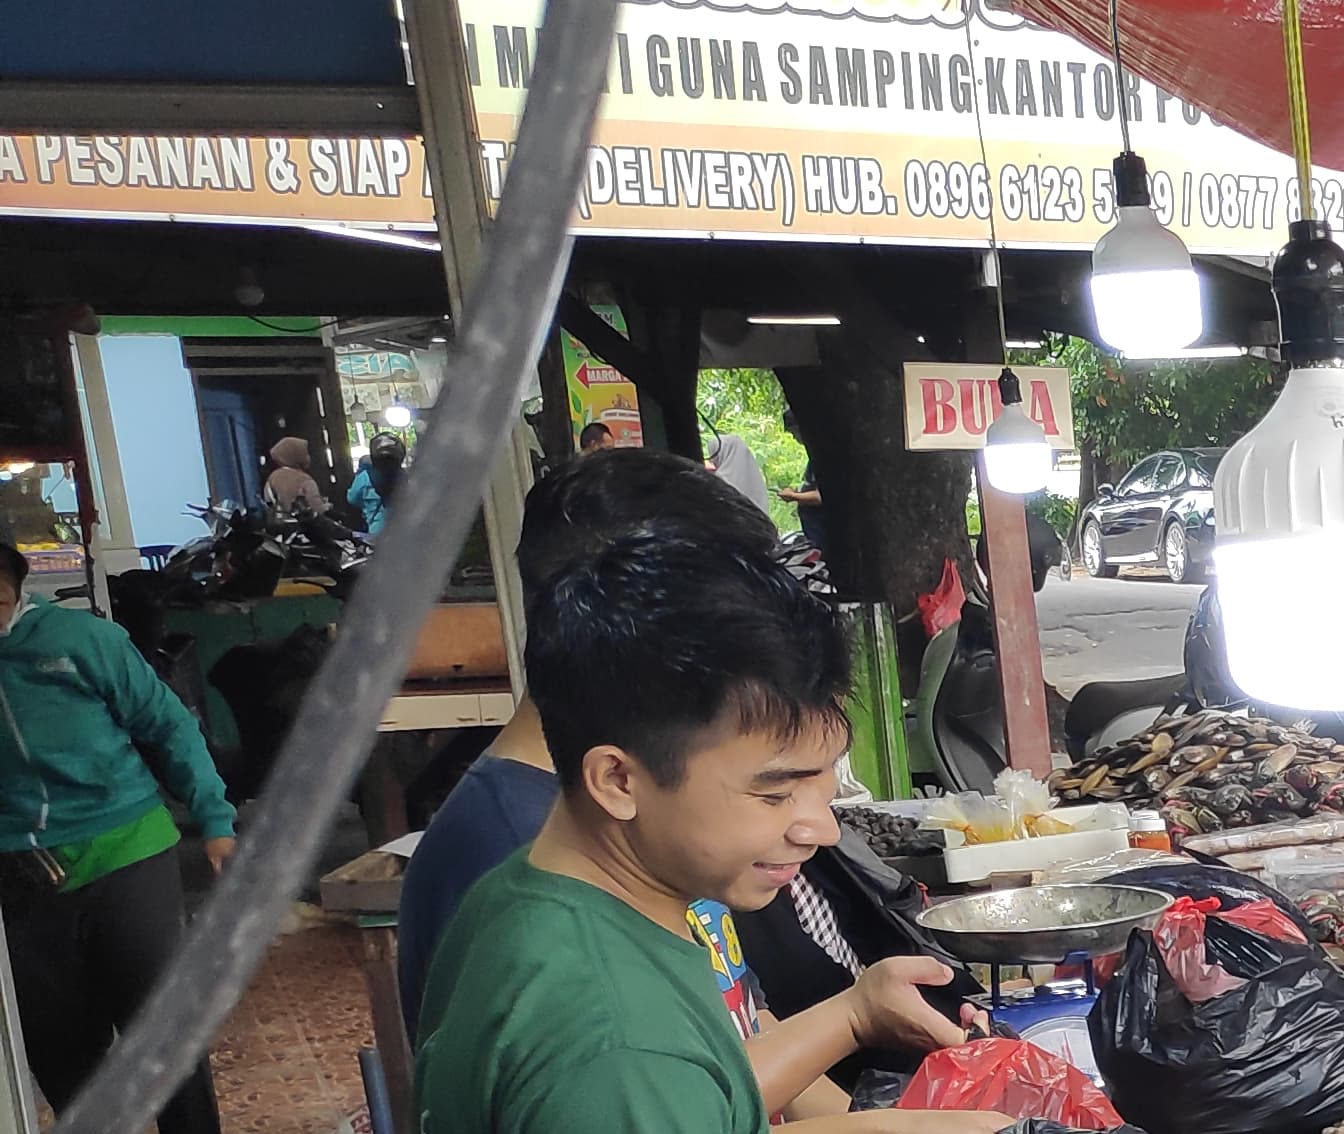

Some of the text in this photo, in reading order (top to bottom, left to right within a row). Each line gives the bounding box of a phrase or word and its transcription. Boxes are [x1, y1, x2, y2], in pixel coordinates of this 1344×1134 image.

[646, 33, 768, 102] GUNA
[778, 42, 973, 114] SAMPING
[984, 56, 1142, 122] KANTOR
[35, 136, 255, 193] PESANAN
[264, 136, 300, 194] &
[308, 138, 410, 197] SIAP
[577, 146, 795, 226] (DELIVERY)
[802, 156, 898, 215] HUB.
[904, 159, 992, 219] 0896
[1000, 165, 1085, 222] 6123
[1092, 168, 1175, 226] 59
[1200, 173, 1278, 230] 0877
